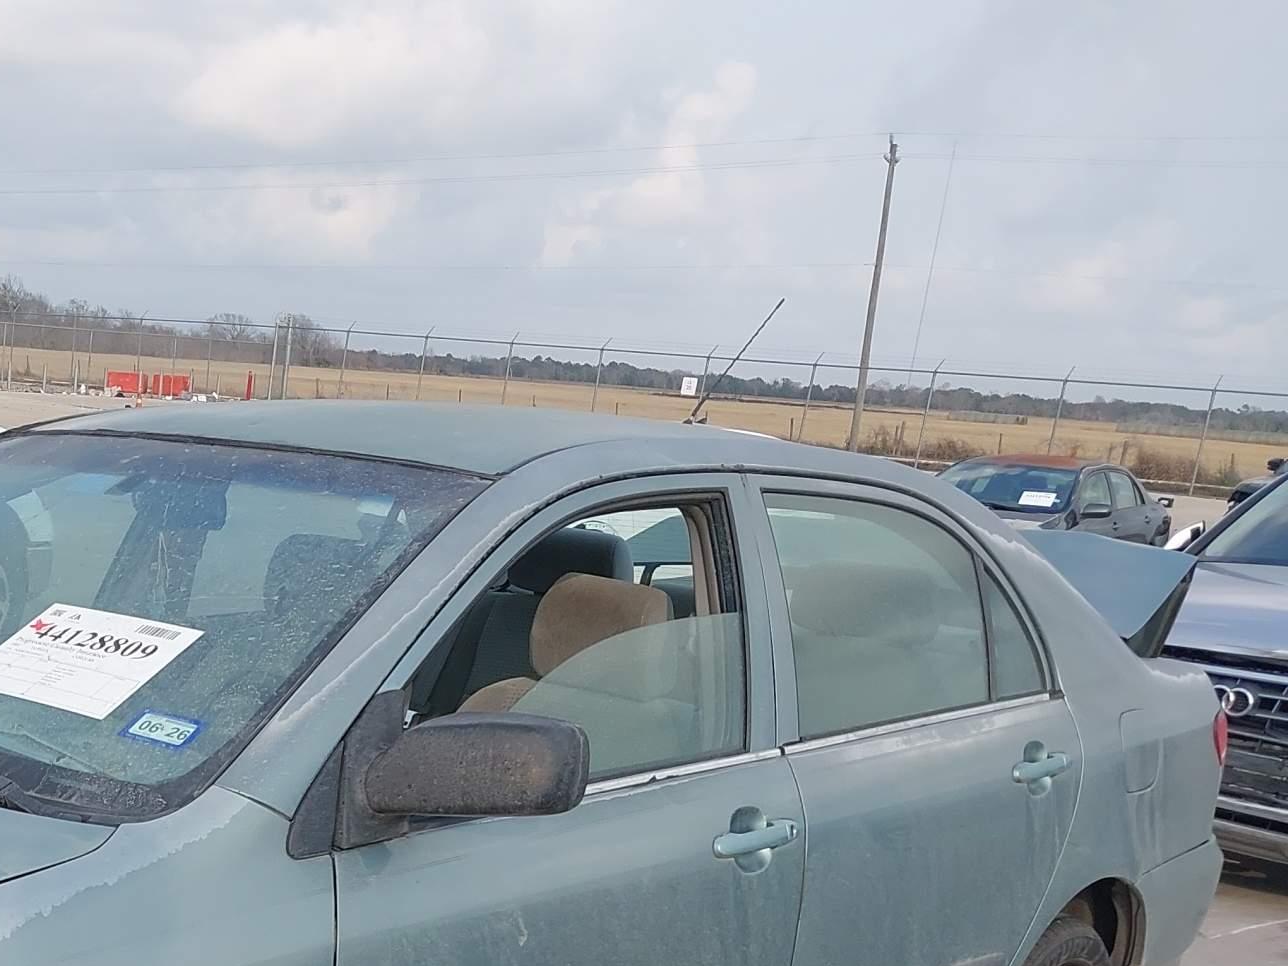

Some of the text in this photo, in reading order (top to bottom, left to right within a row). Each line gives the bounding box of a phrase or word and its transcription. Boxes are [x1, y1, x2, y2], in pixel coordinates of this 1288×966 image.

[34, 623, 158, 660] 44128809
[138, 720, 190, 741] 06 26
